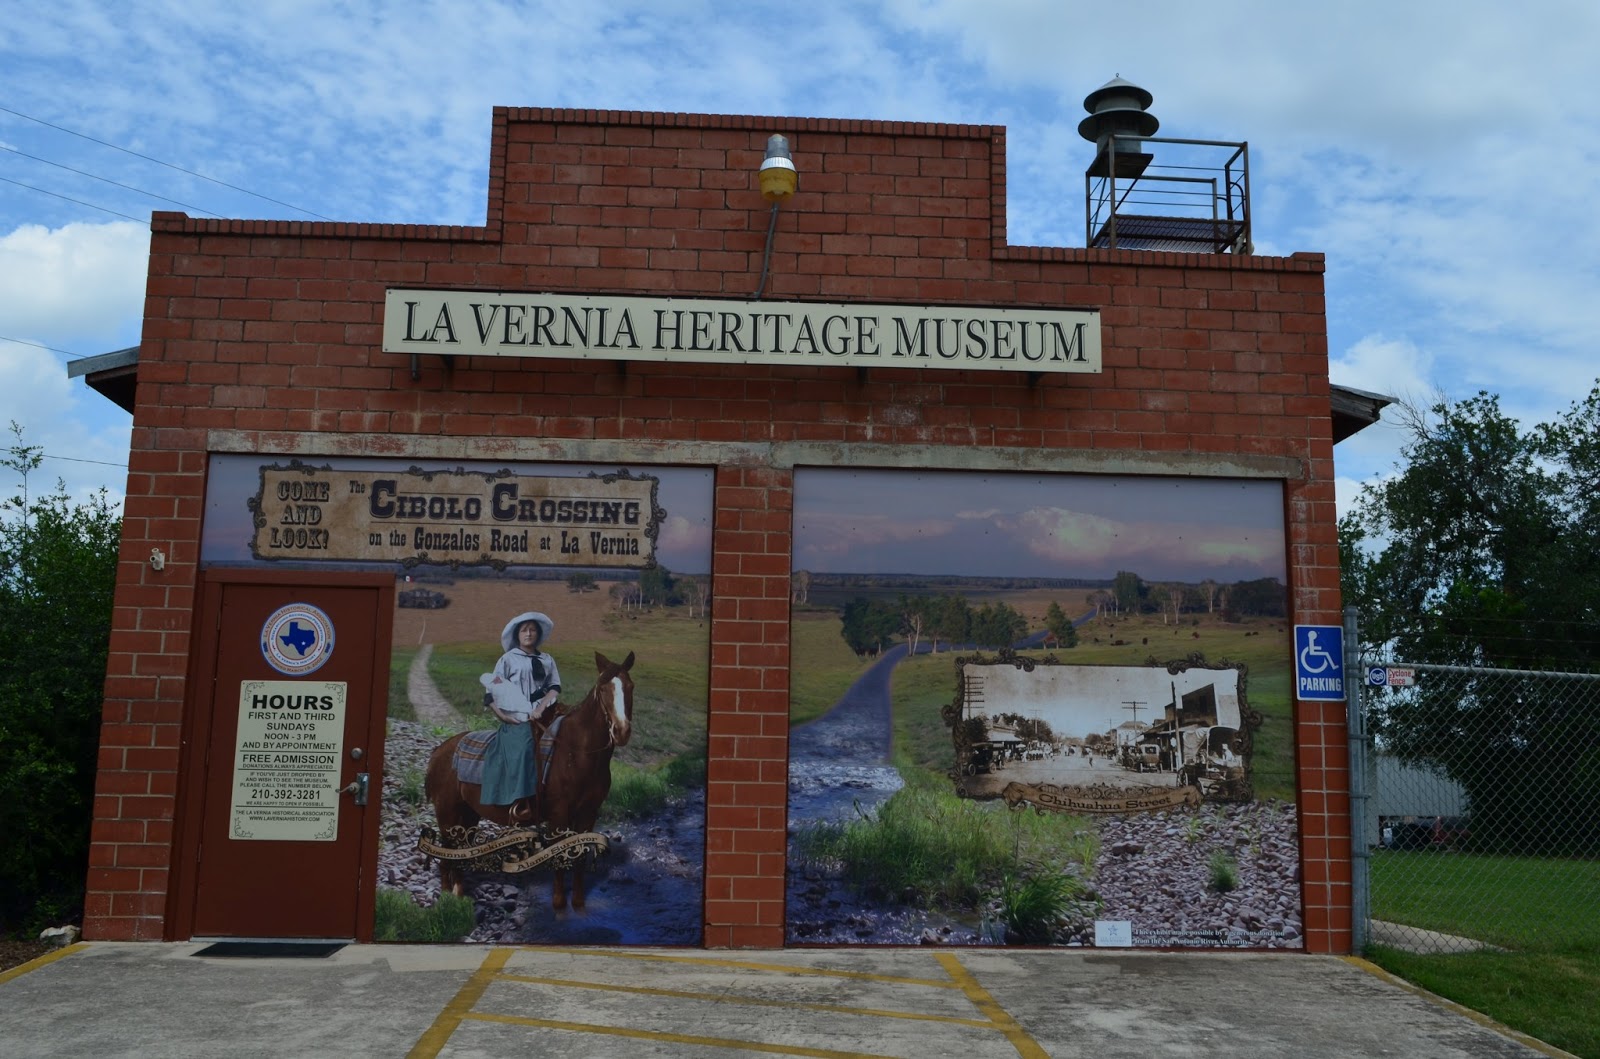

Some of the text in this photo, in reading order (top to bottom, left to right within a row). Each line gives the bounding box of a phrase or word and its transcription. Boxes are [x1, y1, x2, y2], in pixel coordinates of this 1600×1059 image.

[402, 301, 1089, 363] LA VERNIA HERITAGE MUSEUM
[277, 480, 330, 502] COME
[349, 480, 366, 494] The
[280, 505, 322, 525] AND
[269, 527, 329, 549] LOOK!
[369, 527, 639, 555] on the Gonzales Road at La Vernia
[1388, 668, 1412, 678] Cyclone
[1300, 677, 1342, 692] PARKING
[1388, 677, 1406, 685] Fence
[252, 694, 333, 710] HOURS
[248, 711, 335, 721] FIRST AND THIRD
[266, 722, 316, 731] SUNDAYS
[242, 741, 261, 749] AND
[275, 742, 337, 750] APPOINTMENT
[242, 754, 334, 764] FREE ADMISSION
[251, 789, 321, 800] 210-392-3281
[1038, 793, 1172, 810] Chihuahua Street
[420, 844, 467, 858] Susanna
[516, 836, 598, 871] Alamo Survivor
[1188, 929, 1214, 937] possible
